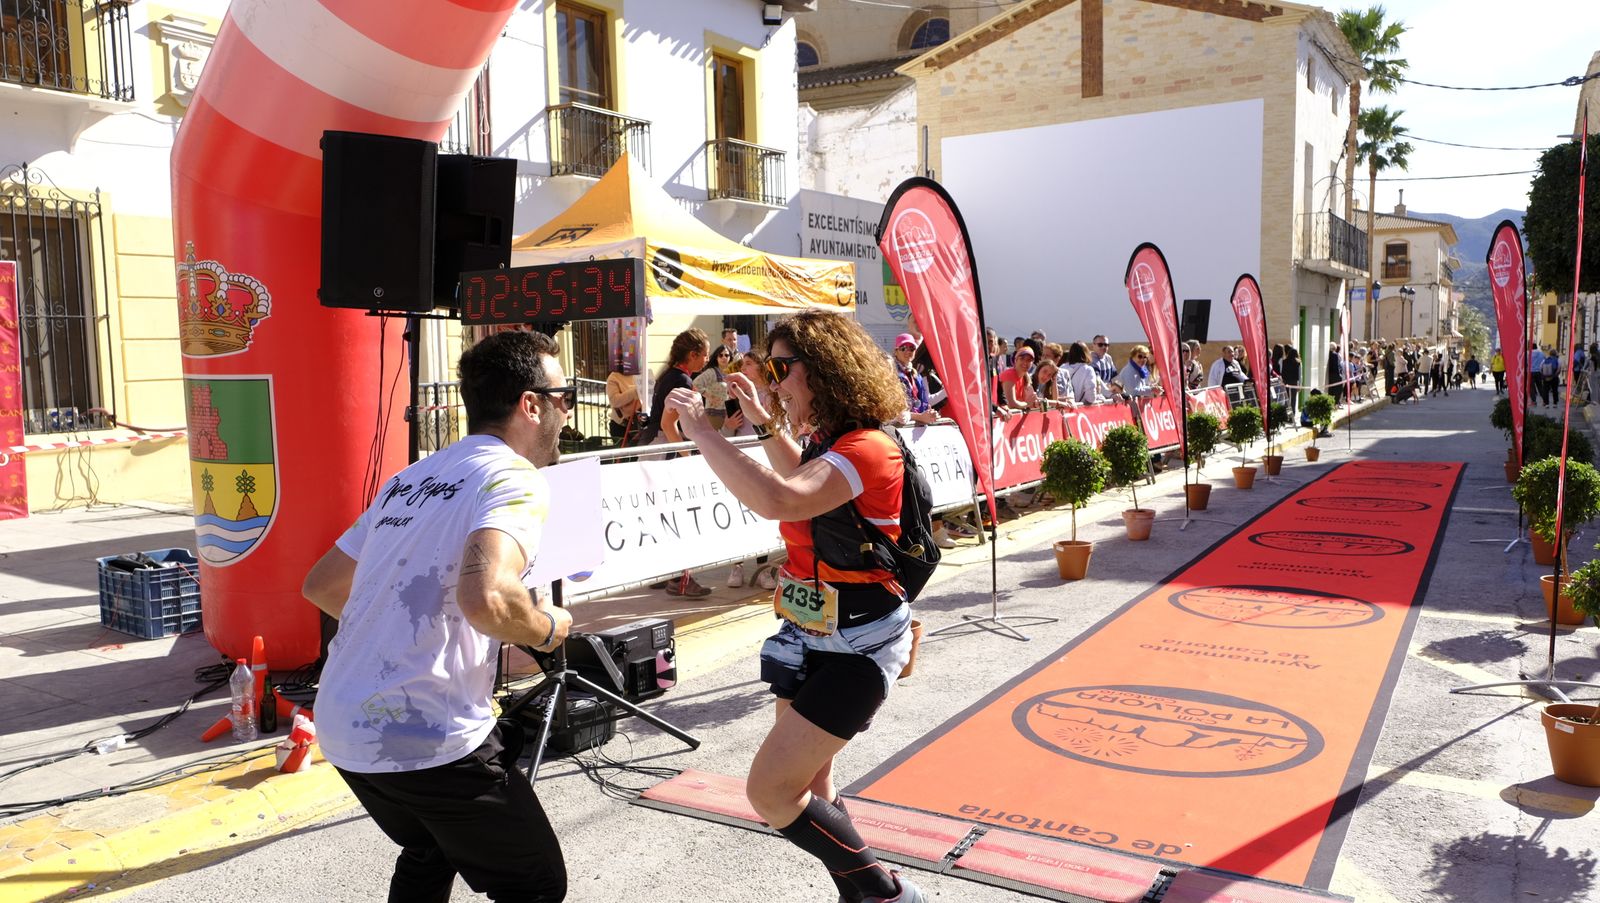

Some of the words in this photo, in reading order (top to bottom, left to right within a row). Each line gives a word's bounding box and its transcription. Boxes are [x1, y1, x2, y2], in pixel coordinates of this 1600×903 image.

[809, 238, 877, 260] AYUNTAMIENTO
[466, 267, 632, 319] 02:55:34
[783, 583, 822, 612] 435
[1137, 643, 1322, 671] Ayuntamiento
[1161, 638, 1270, 656] Cantoria
[1277, 652, 1310, 662] de
[1076, 691, 1233, 721] POLVORA
[1247, 715, 1290, 730] LA
[957, 804, 1119, 845] Cantoria
[1131, 838, 1182, 857] de
